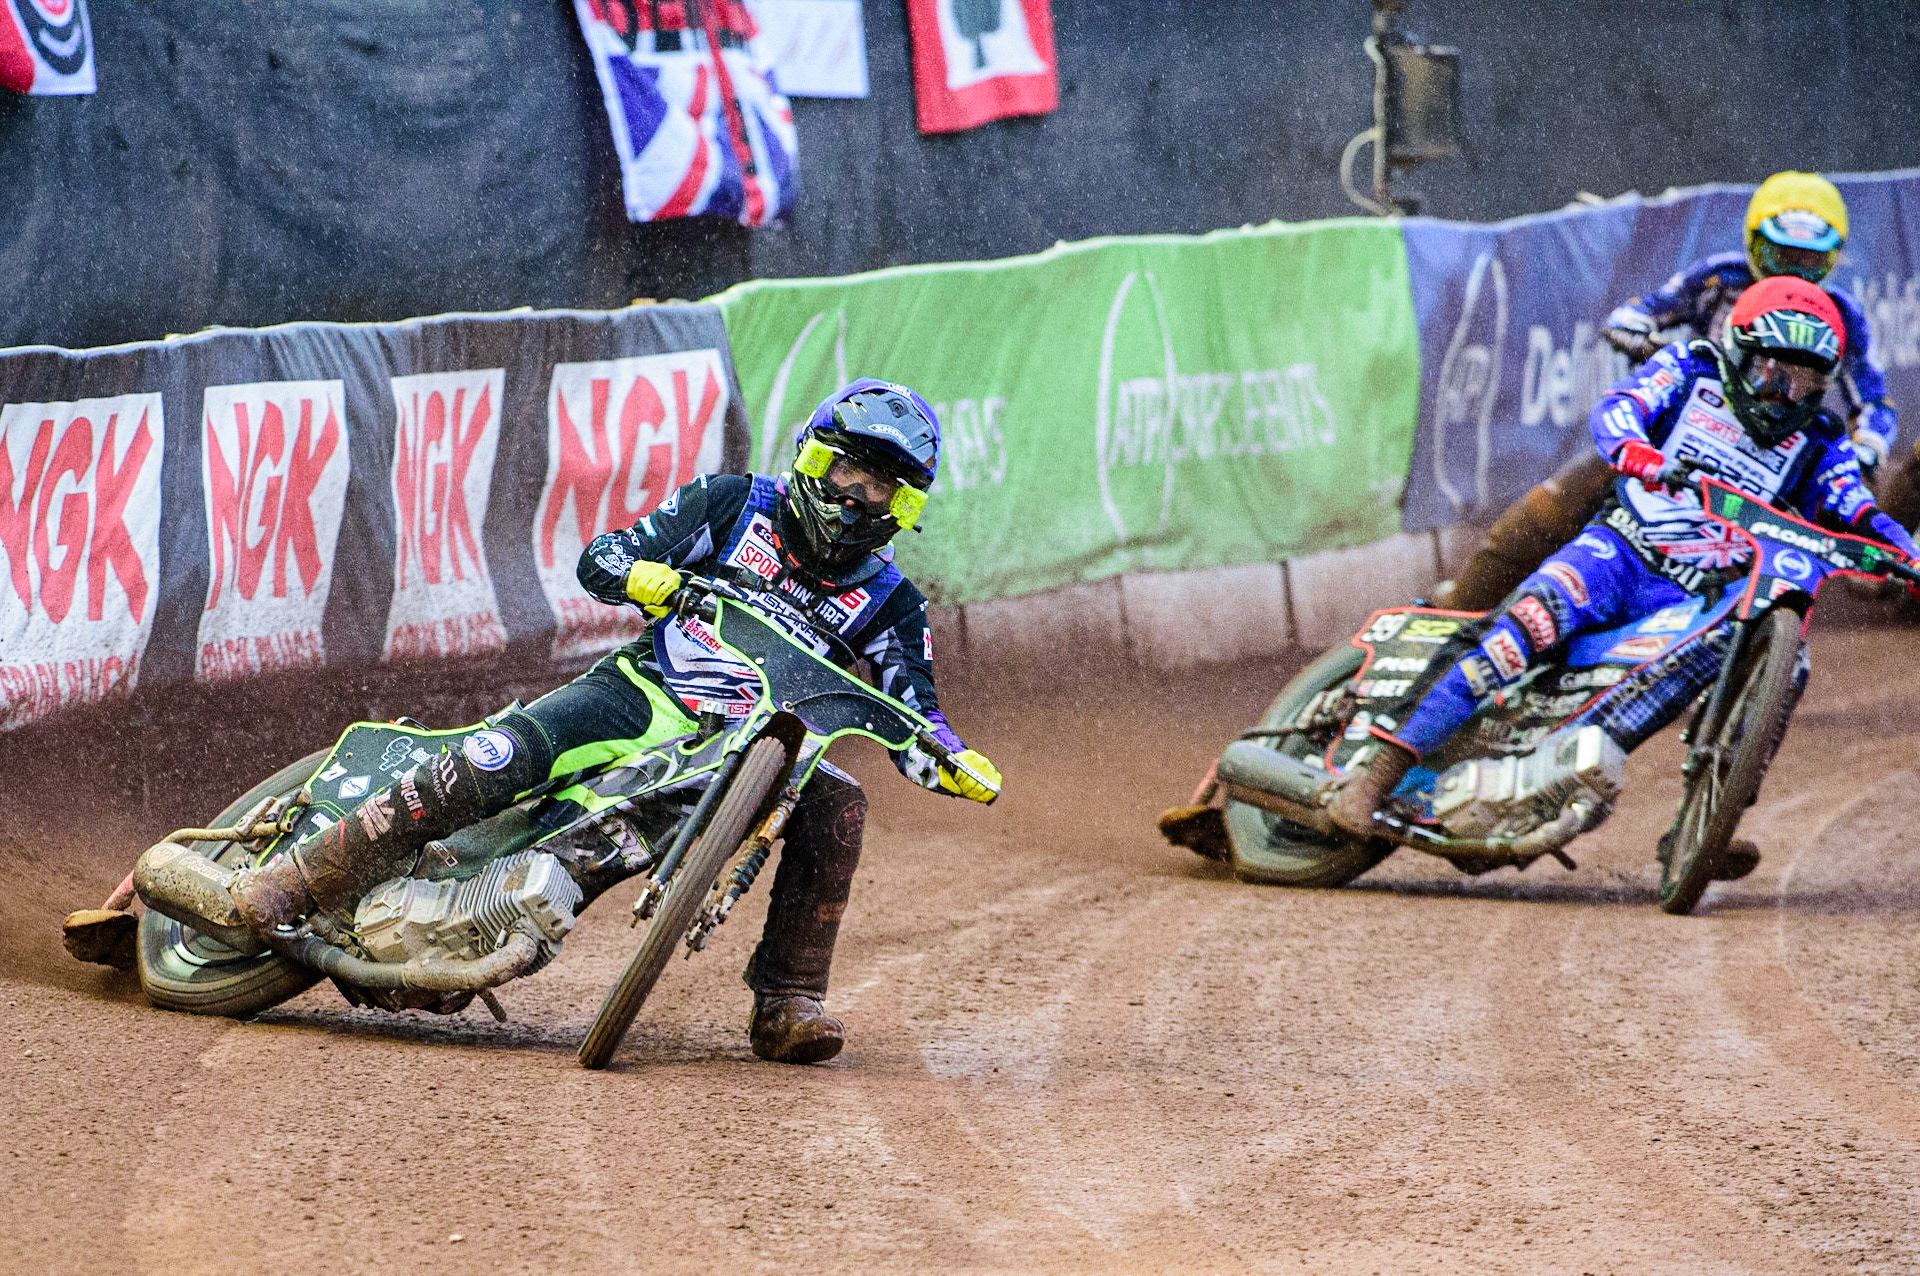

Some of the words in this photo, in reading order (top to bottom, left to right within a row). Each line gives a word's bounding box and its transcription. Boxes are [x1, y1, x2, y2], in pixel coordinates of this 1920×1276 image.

[0, 407, 154, 625] NGK
[207, 397, 341, 612] NGK
[394, 382, 491, 592] NGK
[684, 618, 722, 652] BRITISH
[475, 736, 501, 762] ATPI
